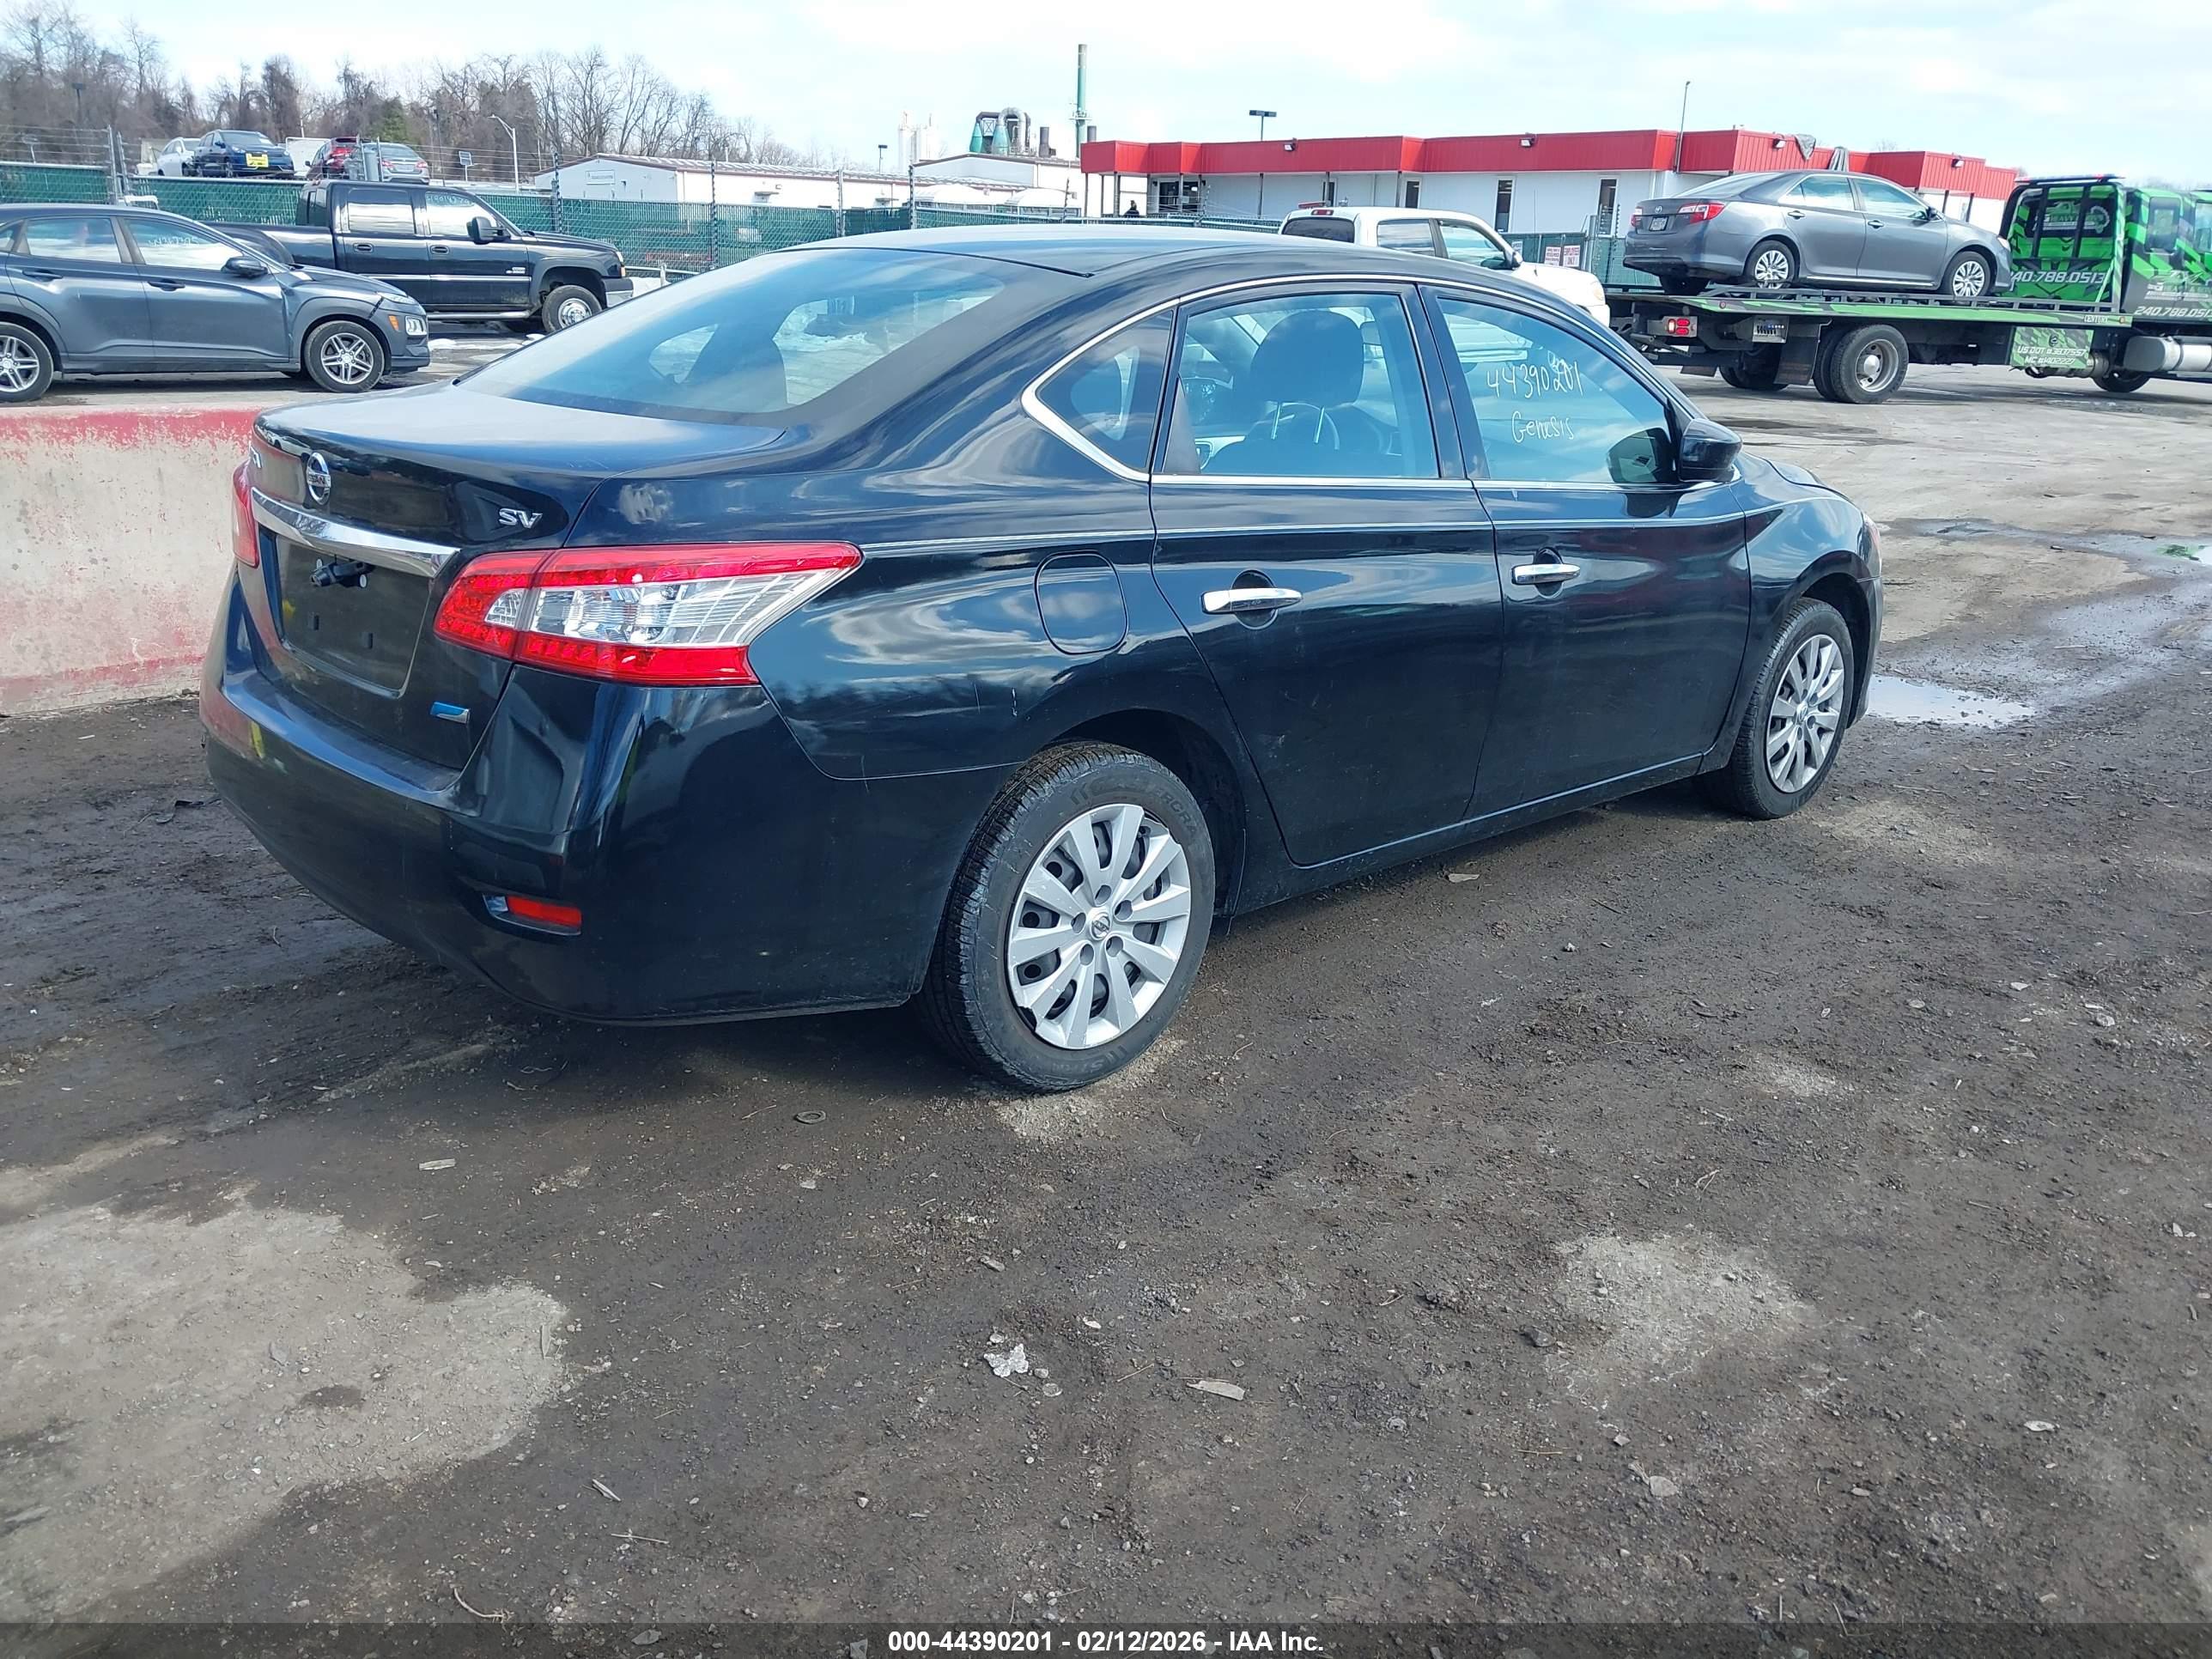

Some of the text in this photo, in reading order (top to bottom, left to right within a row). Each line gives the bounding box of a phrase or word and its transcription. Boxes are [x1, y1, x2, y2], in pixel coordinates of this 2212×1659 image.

[1487, 359, 1583, 398] 44390201
[1511, 410, 1574, 443] Genesis
[499, 507, 543, 528] SV
